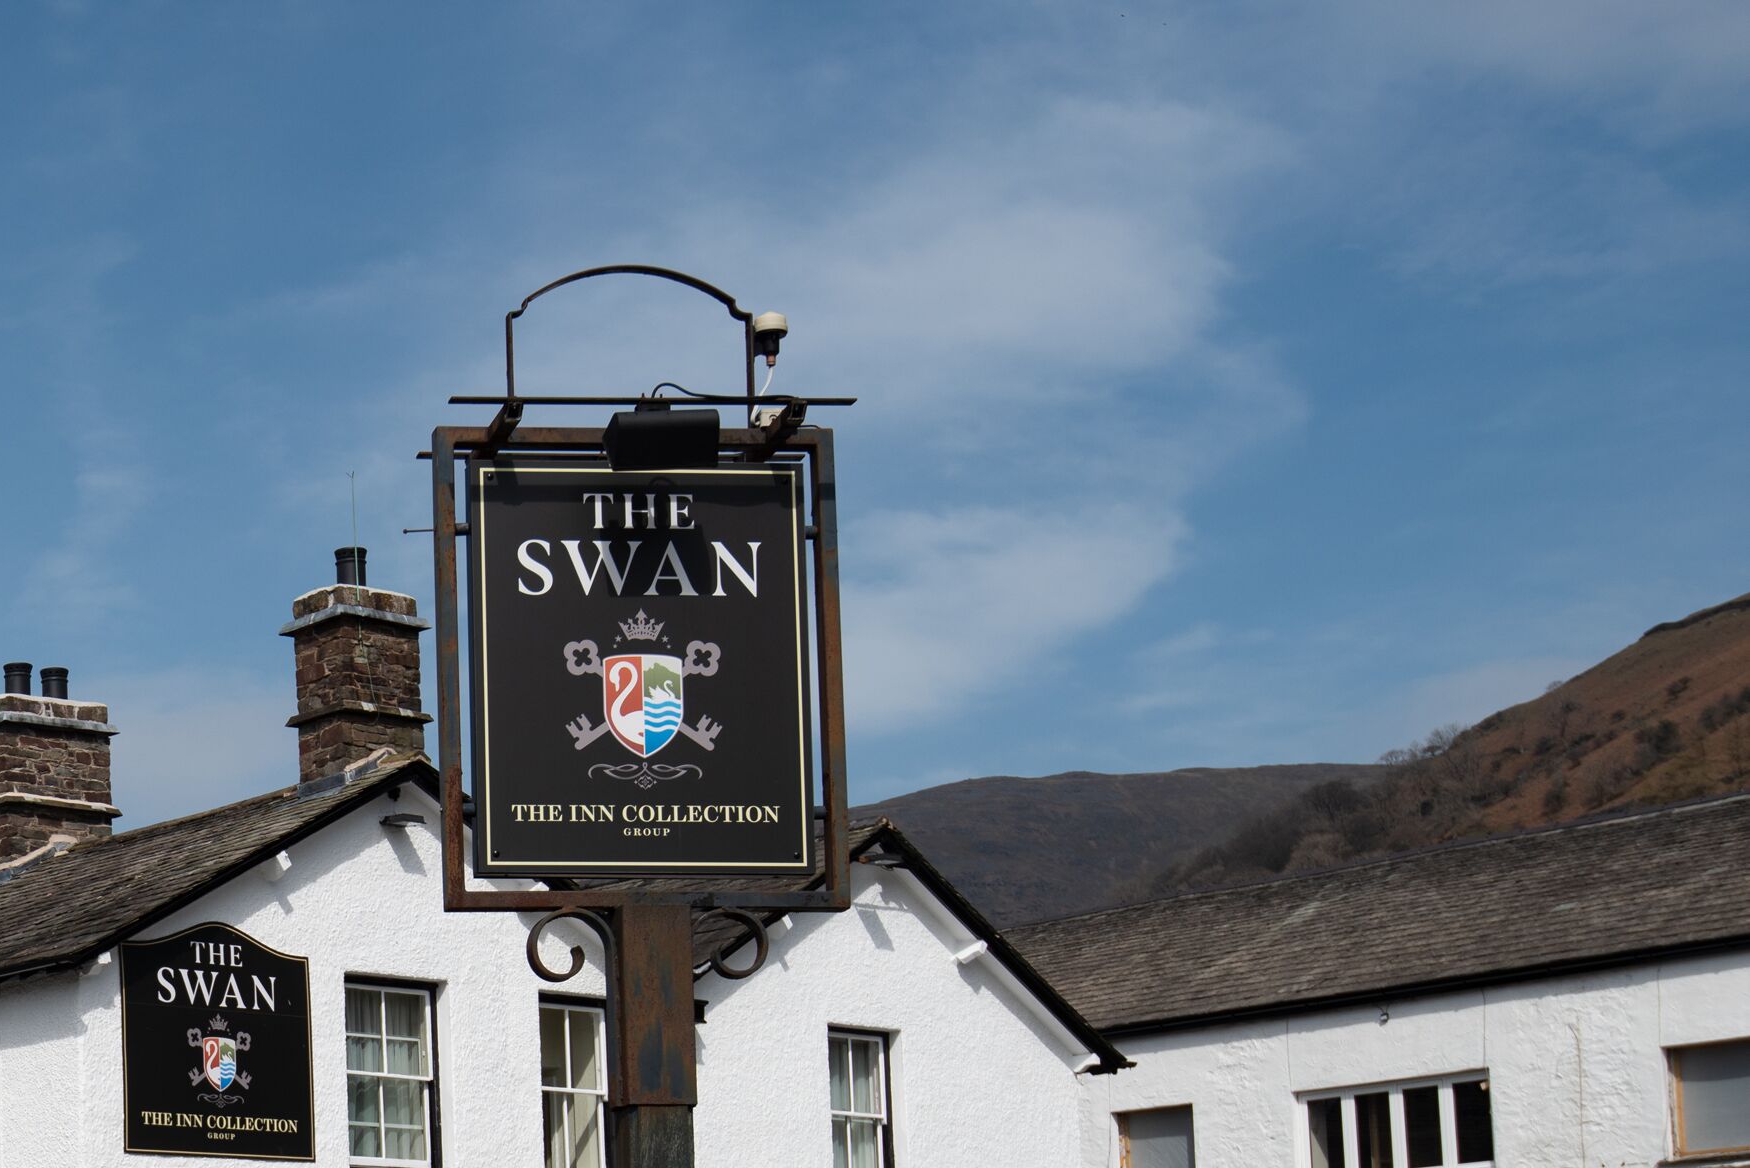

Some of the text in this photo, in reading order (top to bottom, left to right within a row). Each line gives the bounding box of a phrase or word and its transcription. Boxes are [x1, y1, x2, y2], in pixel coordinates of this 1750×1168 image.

[582, 493, 695, 530] THE
[516, 539, 762, 598] SWAN
[511, 804, 781, 824] THE INN COLLECTION
[623, 827, 671, 837] GROUP
[190, 941, 243, 967] THE
[156, 966, 277, 1012] SWAN
[141, 1111, 298, 1133] THE INN COLLECTION
[207, 1132, 236, 1141] GROUP
